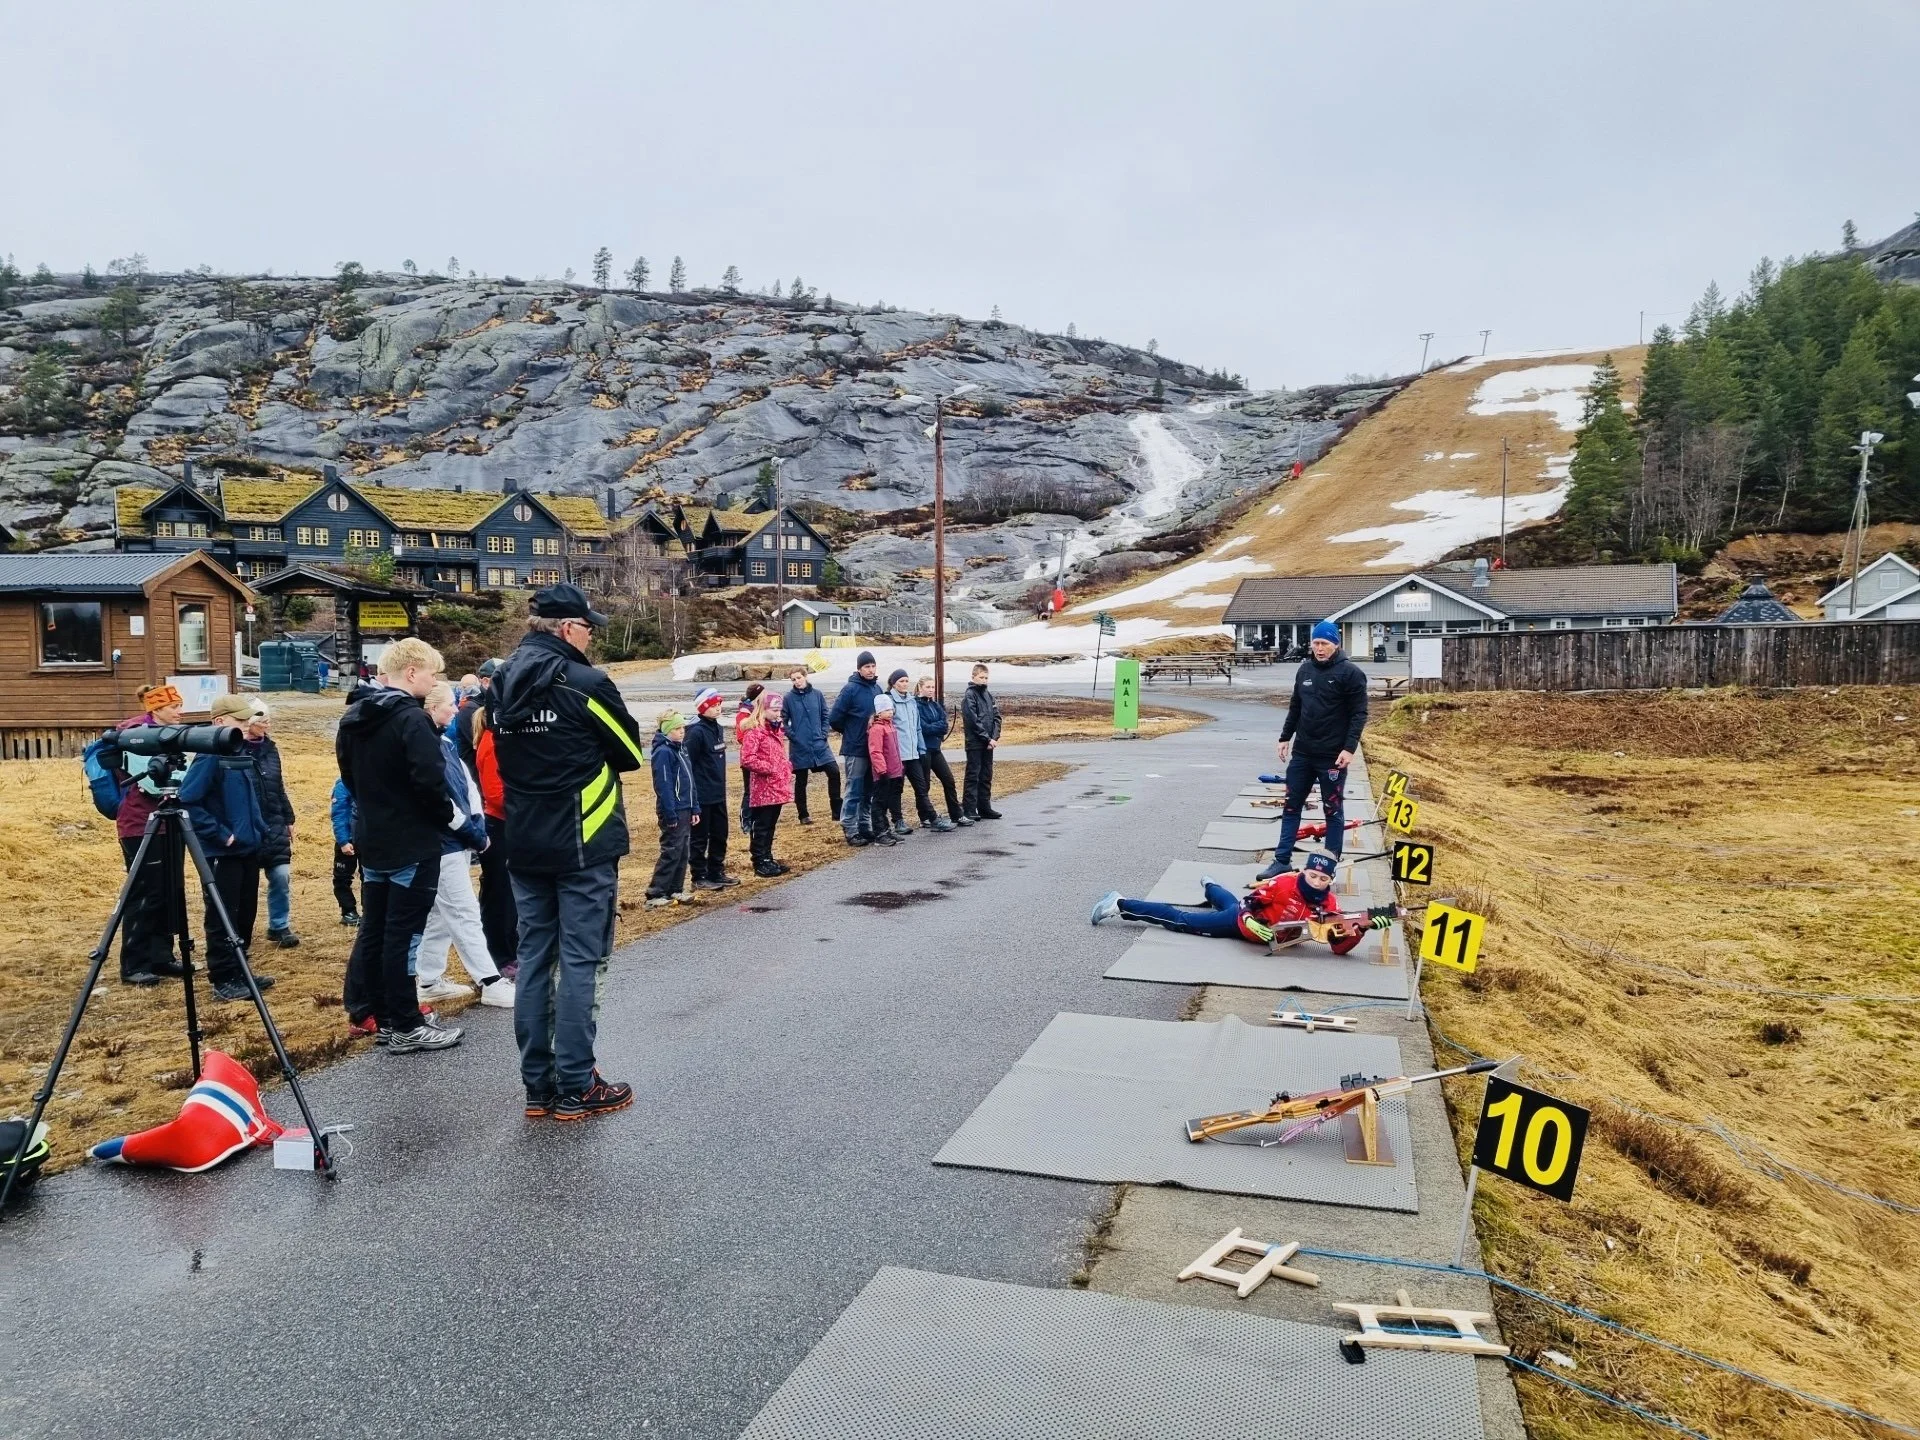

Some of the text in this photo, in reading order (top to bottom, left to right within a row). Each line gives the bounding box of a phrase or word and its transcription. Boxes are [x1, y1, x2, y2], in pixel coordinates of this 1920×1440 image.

[1122, 678, 1131, 707] MÅL
[1387, 773, 1407, 794] 14
[1393, 799, 1413, 828] 13
[1396, 845, 1430, 882] 12
[1430, 911, 1473, 965] 11
[1487, 1092, 1572, 1186] 10
